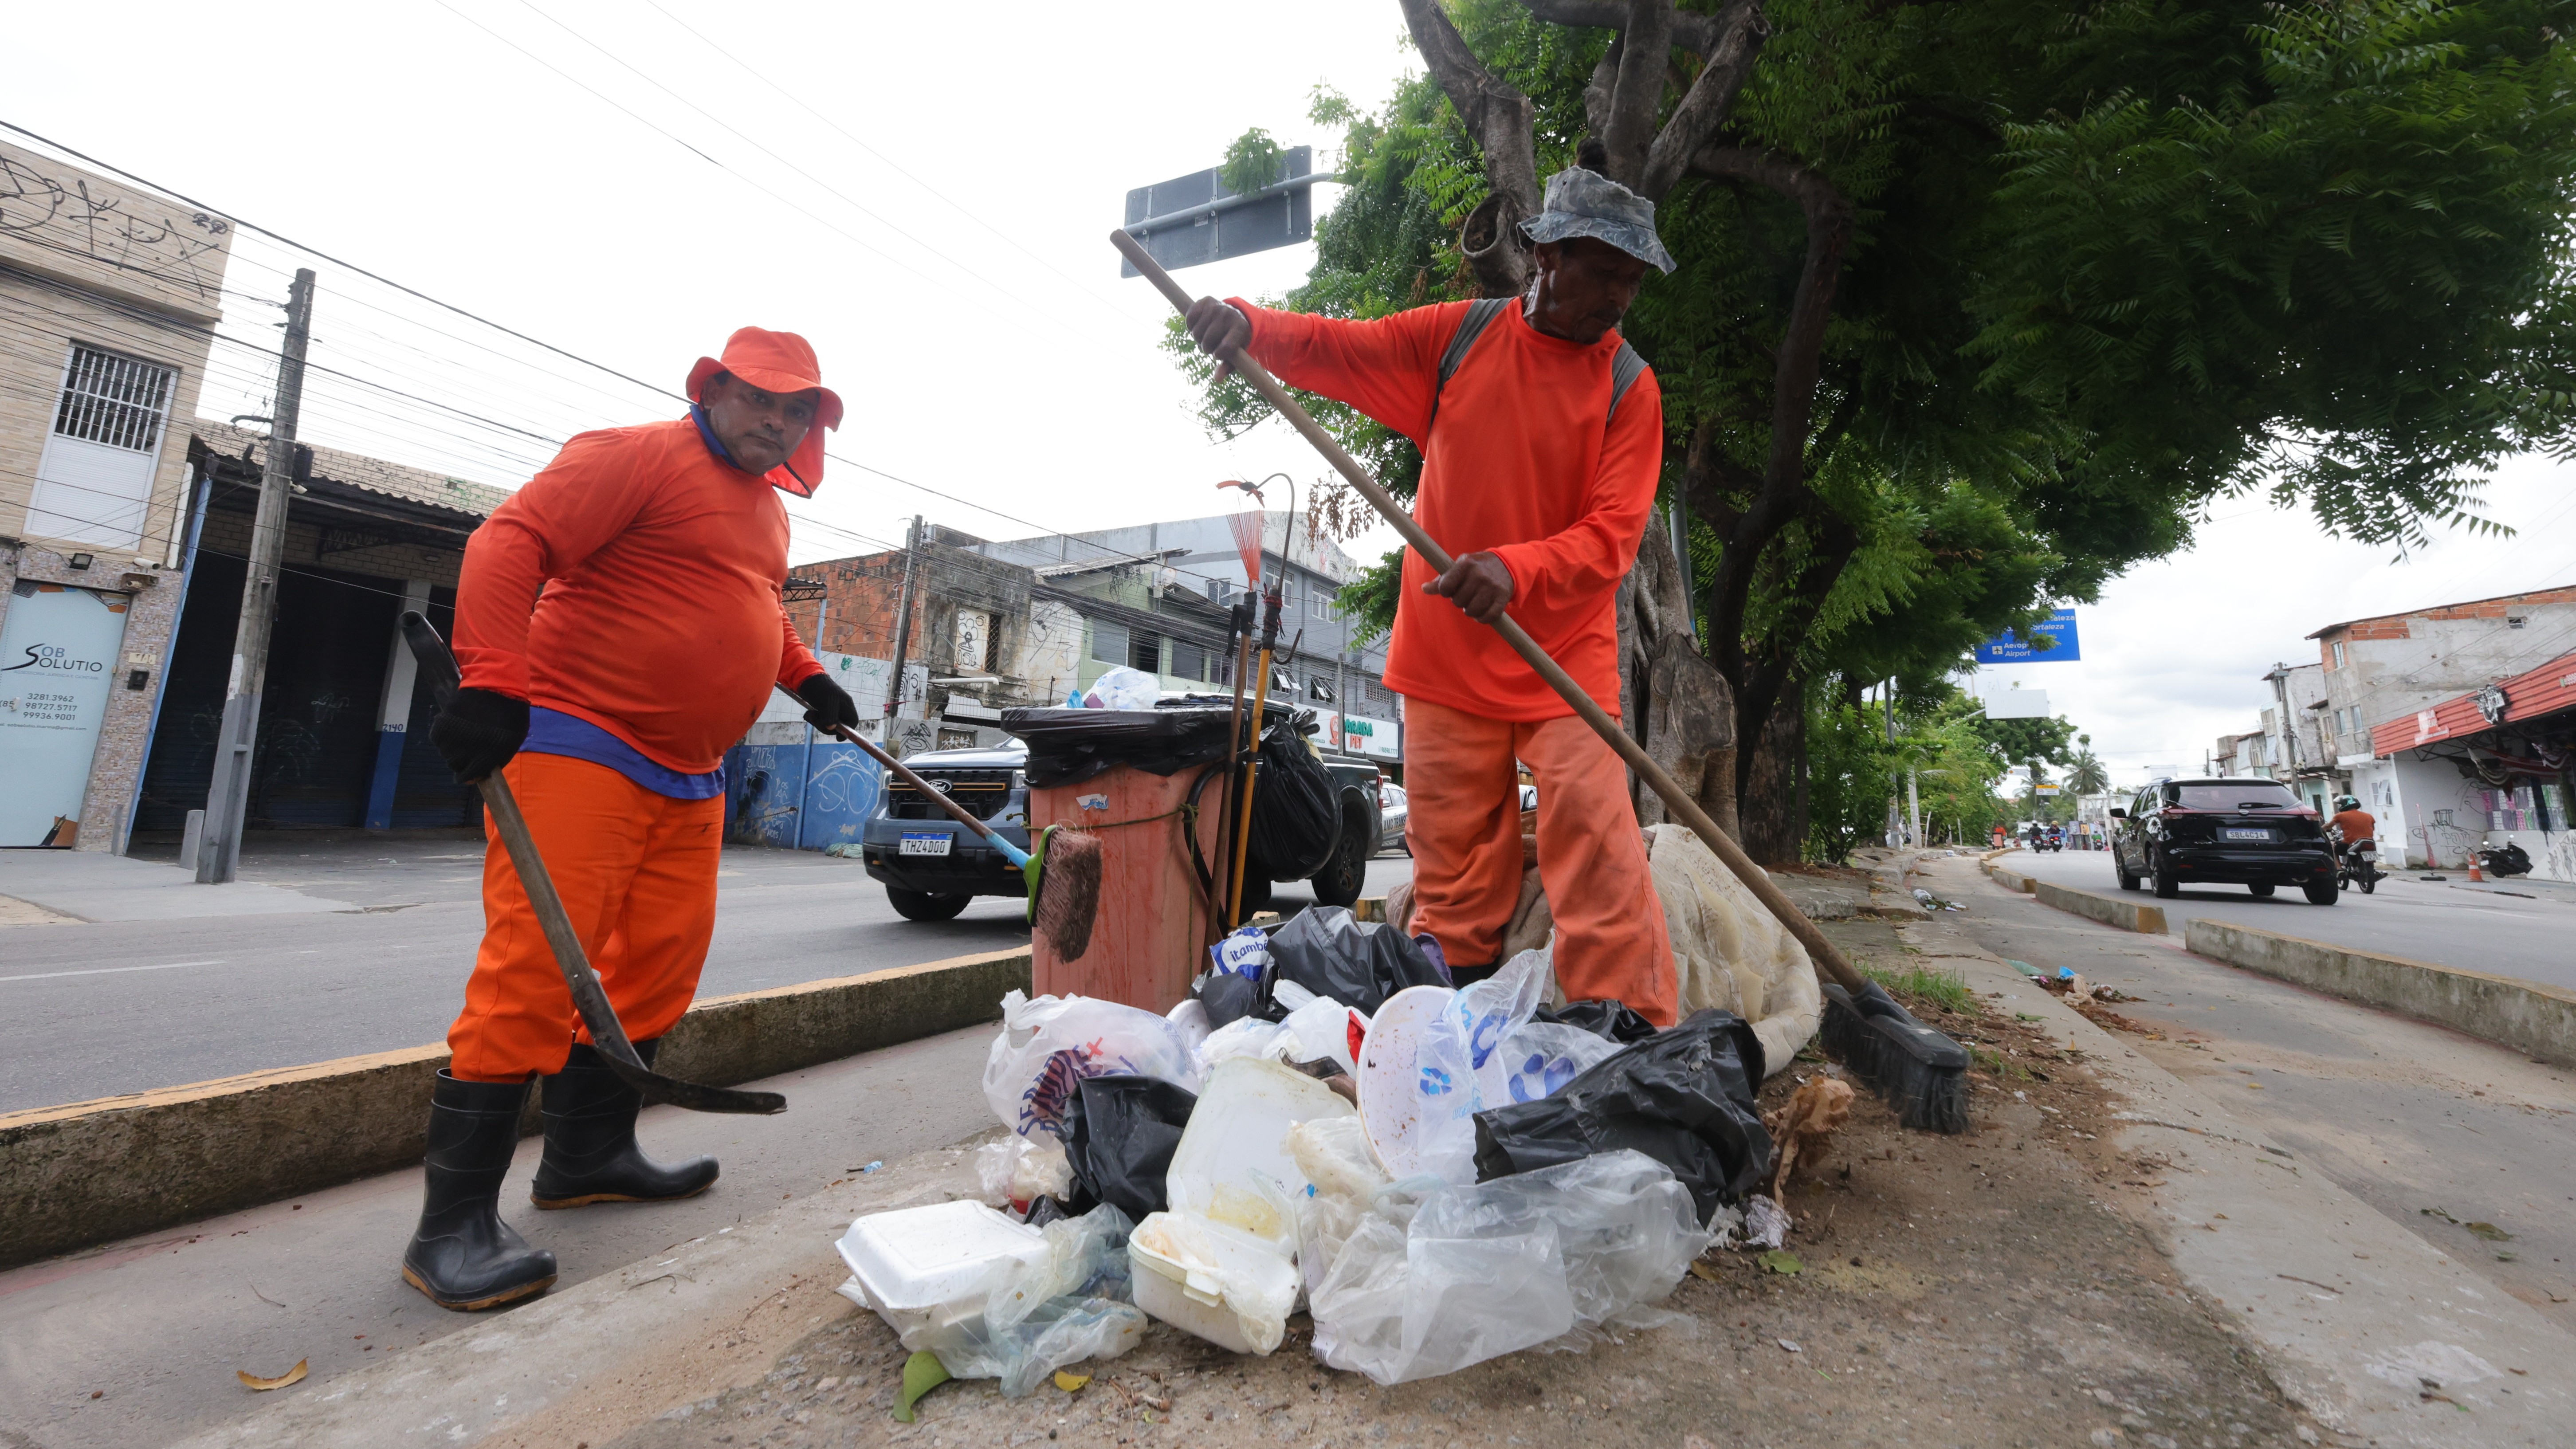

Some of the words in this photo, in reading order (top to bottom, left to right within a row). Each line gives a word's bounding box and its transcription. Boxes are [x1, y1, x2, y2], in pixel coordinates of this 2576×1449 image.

[27, 693, 74, 702] 3281.3962
[25, 702, 77, 711] 98727.5717
[23, 711, 75, 721] 99936.9001
[383, 723, 403, 732] 2140
[1344, 718, 1373, 737] ARADA
[1350, 735, 1363, 749] PET
[1384, 818, 1393, 832] AMC
[1394, 814, 1408, 829] TRÂNS
